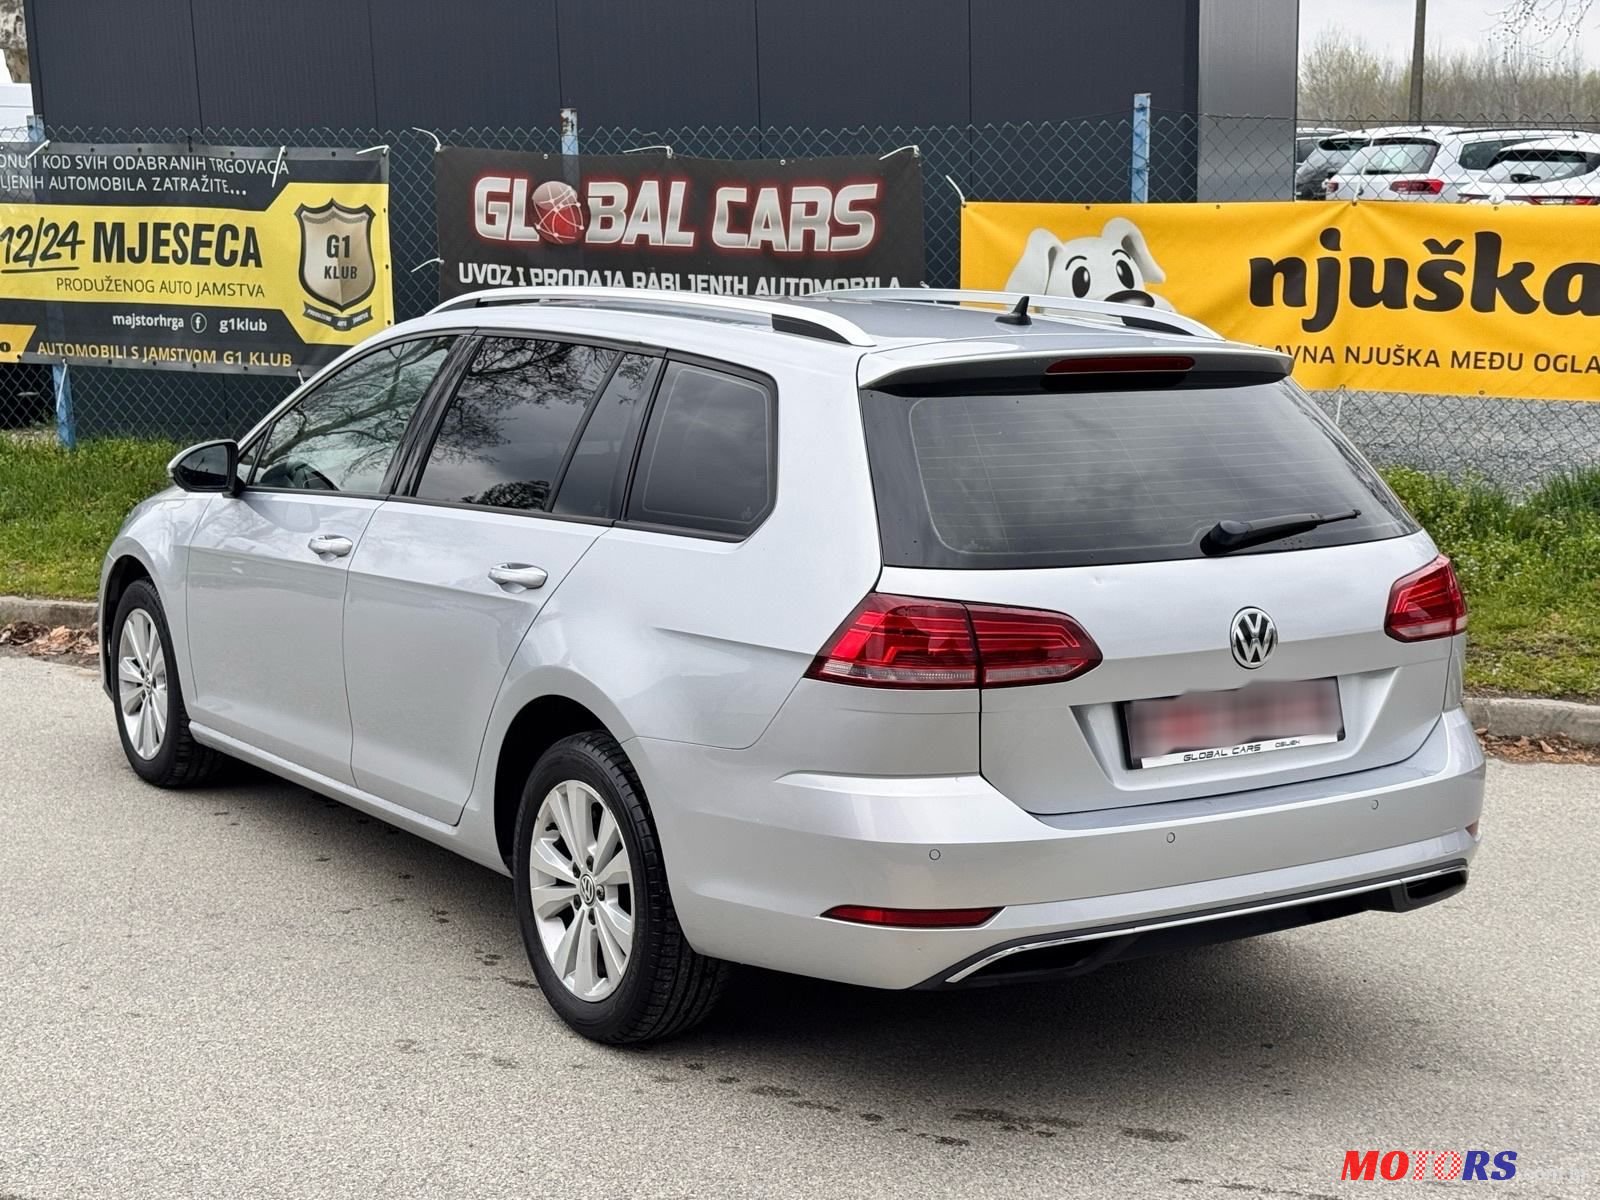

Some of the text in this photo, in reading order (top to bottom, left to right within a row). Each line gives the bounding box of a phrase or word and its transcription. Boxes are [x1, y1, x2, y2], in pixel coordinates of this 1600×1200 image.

[42, 154, 72, 170] KOD
[75, 154, 108, 171] SVIH
[112, 154, 207, 172] ODABRANIH
[48, 175, 148, 192] AUTOMOBILA
[152, 174, 248, 196] ZATRAŽITE...
[711, 182, 879, 252] CARS
[0, 216, 263, 269] 12/24 MJESECA
[326, 233, 351, 259] G1
[323, 265, 358, 280] KLUB
[459, 262, 514, 286] UVOZ
[516, 266, 527, 287] I
[530, 268, 626, 288] PRODAJA
[1249, 227, 1600, 333] njuška
[56, 275, 266, 299] PRODUŽENOG AUTO JAMSTVA
[112, 313, 185, 331] majstorhrga
[219, 318, 268, 334] g1klub
[37, 342, 292, 368] AUTOMOBILI S JAMSTVOM G1 KLUB
[1344, 343, 1440, 368] NJUŠKA
[1450, 350, 1524, 372] MEĐU
[1184, 749, 1228, 762] GLOBAL
[1232, 744, 1261, 755] CARS
